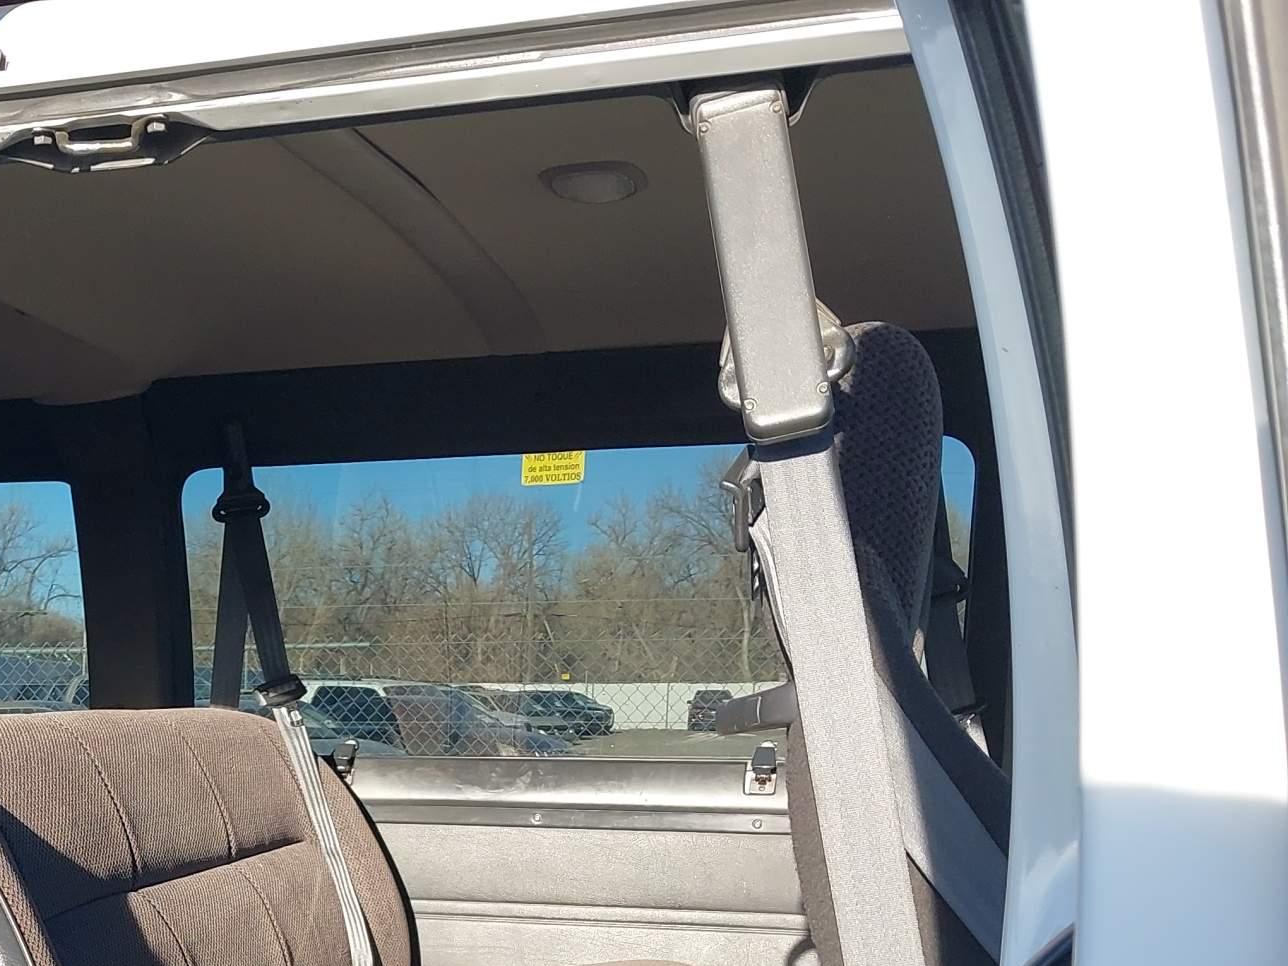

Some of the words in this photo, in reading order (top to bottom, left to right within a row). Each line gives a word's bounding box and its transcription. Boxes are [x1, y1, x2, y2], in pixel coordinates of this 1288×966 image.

[547, 452, 573, 461] TOQUE
[528, 465, 537, 473] de
[538, 464, 552, 473] alta
[545, 471, 582, 482] VOLTIOS
